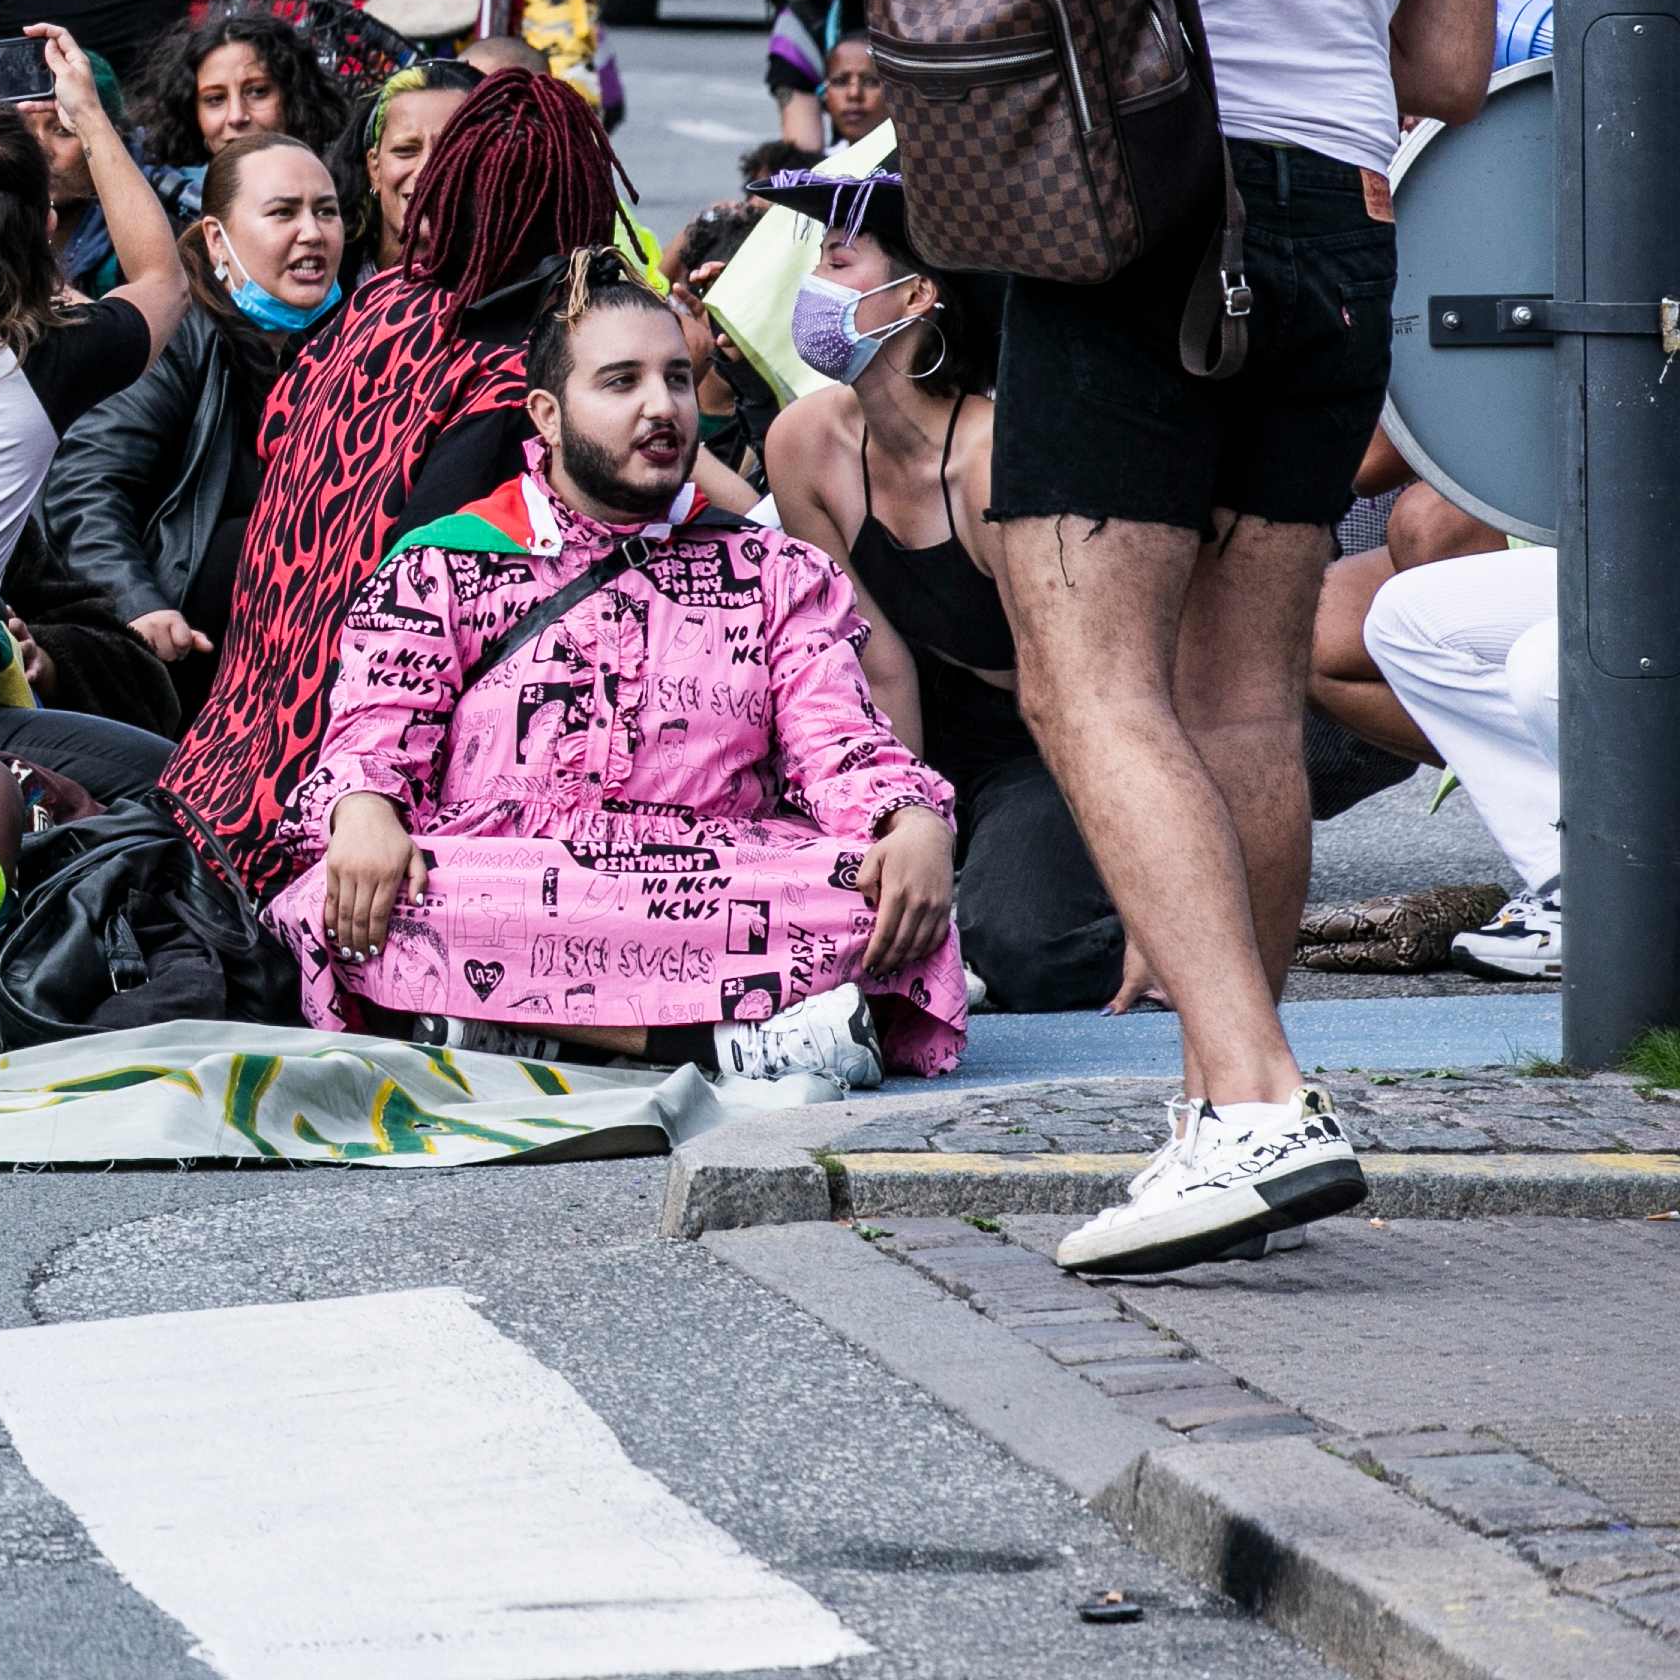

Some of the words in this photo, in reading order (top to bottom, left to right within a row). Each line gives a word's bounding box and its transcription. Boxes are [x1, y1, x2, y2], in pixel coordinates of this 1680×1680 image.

[659, 576, 689, 593] IN
[693, 576, 724, 592] MY
[678, 587, 763, 607] OINTMEN
[473, 612, 497, 634] NO
[725, 625, 749, 643] NO
[394, 648, 452, 672] NEW
[367, 667, 435, 695] NEWS
[573, 842, 607, 856] IN
[611, 842, 643, 856] MY
[594, 853, 712, 871] OINTMENT
[641, 876, 668, 895] NO
[647, 897, 720, 920] NEWS
[618, 939, 717, 984] SUCKS
[787, 922, 816, 1002] TRASH
[820, 934, 838, 974] TALK
[467, 964, 503, 988] LAZY
